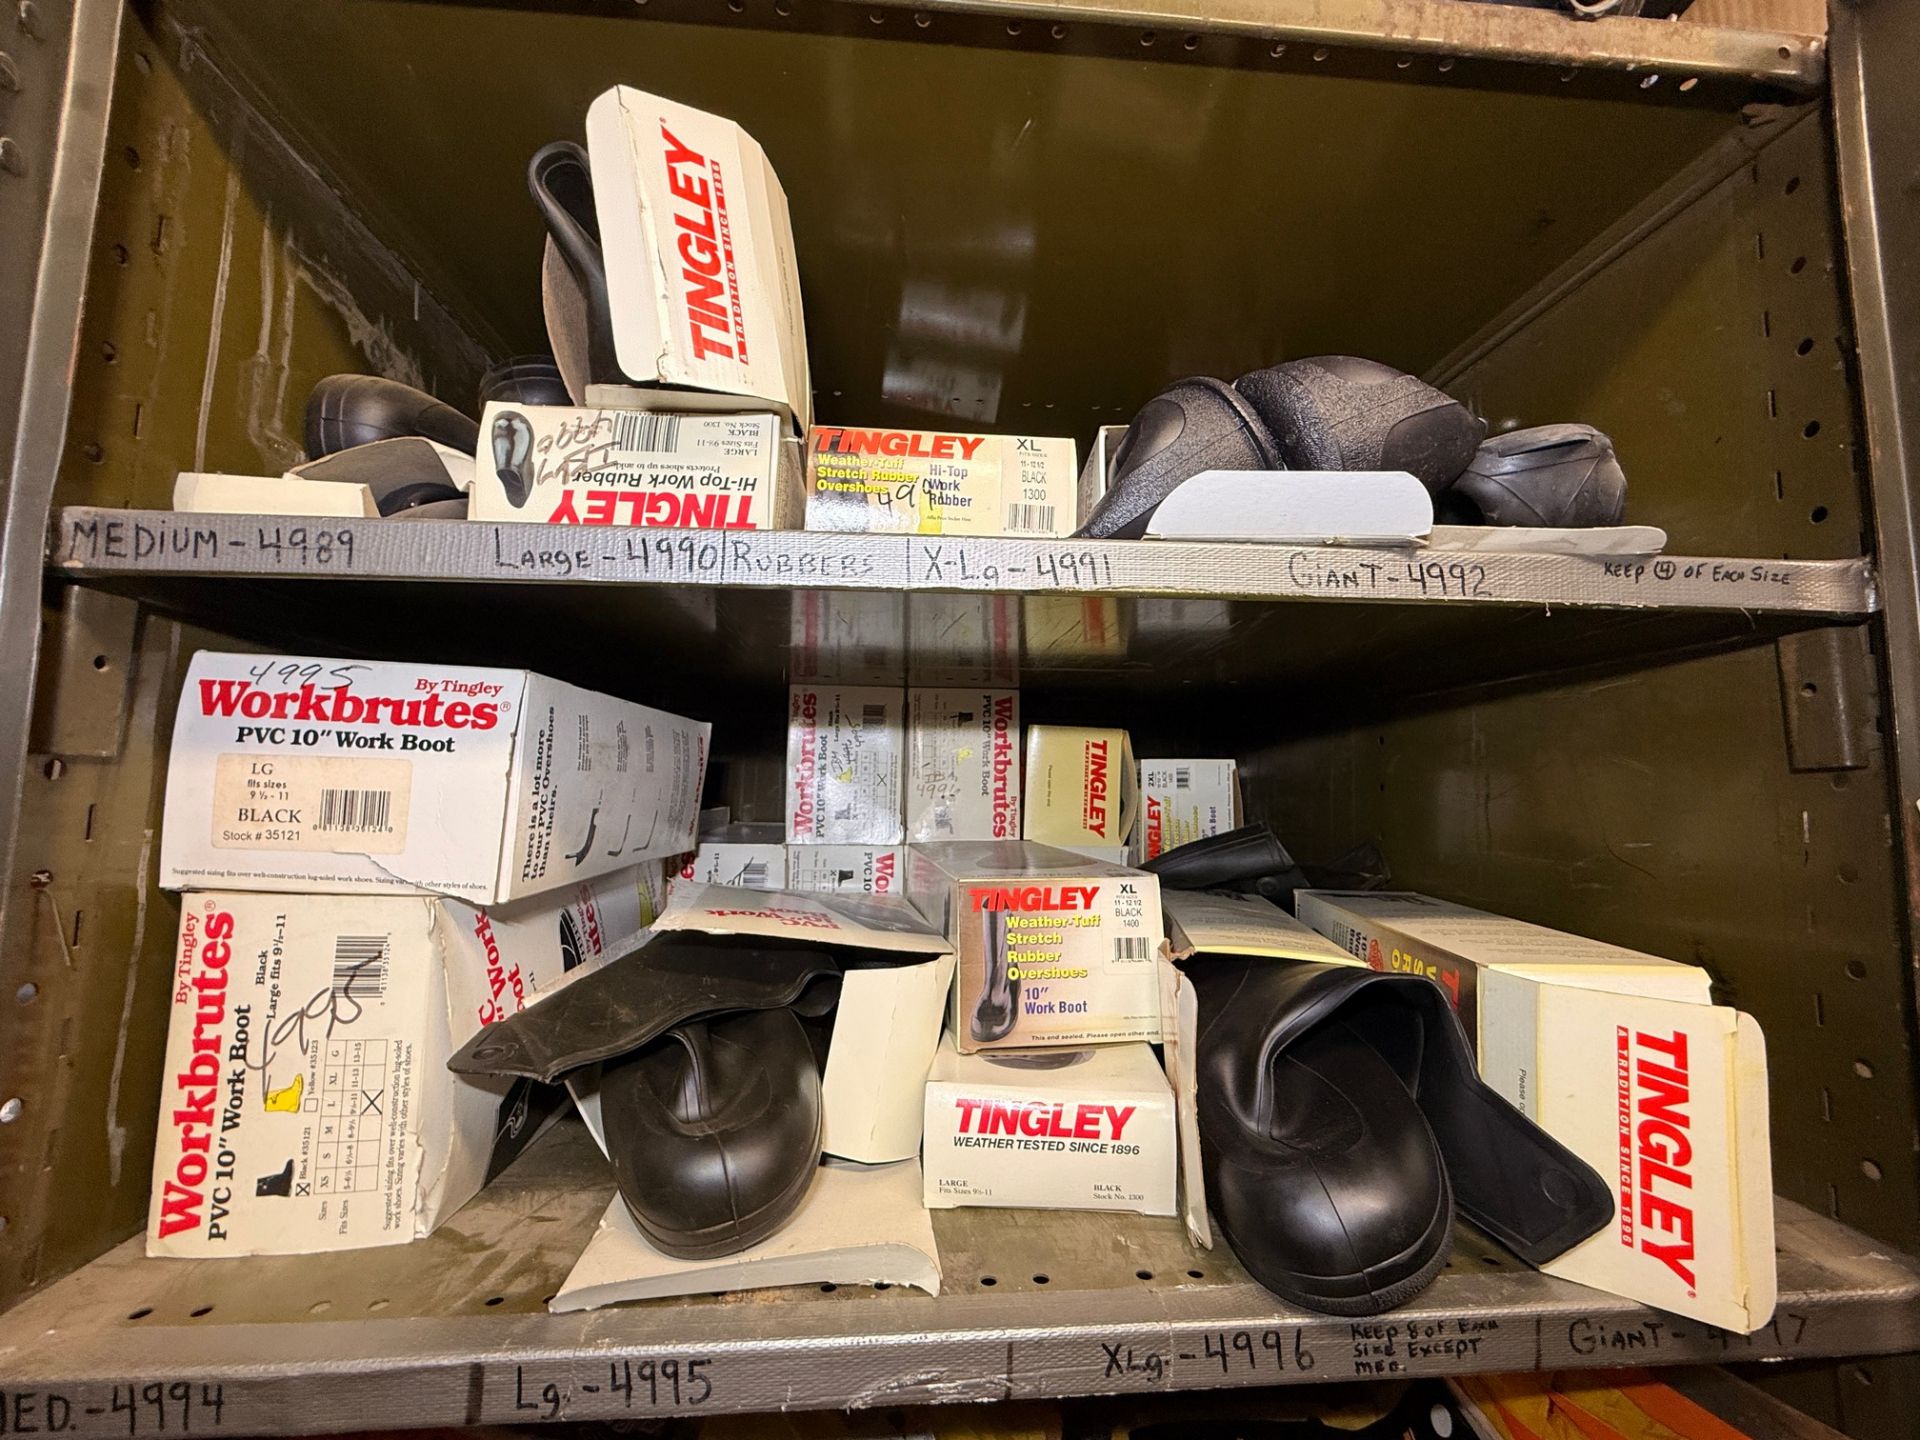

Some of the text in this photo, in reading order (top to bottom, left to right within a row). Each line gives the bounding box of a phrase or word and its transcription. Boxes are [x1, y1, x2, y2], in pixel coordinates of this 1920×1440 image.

[660, 125, 734, 360] TINGLEY
[711, 161, 745, 343] TRADITION SINCE 1896
[814, 428, 985, 460] TINGLEY
[1017, 439, 1042, 451] XL
[660, 464, 684, 472] shoes
[817, 466, 919, 483] Stretch Rubber
[930, 464, 968, 479] Hi-Top
[1022, 470, 1047, 484] BLACK
[572, 471, 757, 491] Hi-Top Work Rubber
[817, 480, 889, 494] Overshoes
[930, 479, 960, 491] Work
[1023, 489, 1046, 500] 1300
[548, 490, 757, 529] TINGLEY
[249, 661, 372, 691] 4995
[414, 677, 504, 698] By Tingley
[235, 727, 285, 745] PVC
[336, 731, 394, 750] Work
[400, 734, 456, 753] Boot
[818, 734, 828, 761] Boot
[981, 694, 991, 796] PVC Work Boot
[251, 762, 274, 776] LG
[993, 696, 1013, 838] Workbrutes
[247, 779, 287, 790] fits sizes
[530, 706, 555, 880] to our PVC Overshoes
[1088, 740, 1108, 839] TINGLEY
[237, 807, 302, 824] BLACK
[522, 729, 545, 882] There is lot more
[1008, 796, 1017, 838] By Tingley
[223, 830, 301, 841] Stock # 35121
[539, 784, 557, 878] than theirs.
[816, 814, 825, 838] PVC
[863, 852, 873, 876] PVC
[968, 886, 1100, 913] TINGLEY
[1119, 884, 1137, 894] XL
[1006, 915, 1101, 929] Weather-Tuff
[1115, 908, 1143, 917] BLACK
[1123, 919, 1139, 928] 1400
[1007, 932, 1063, 945] Stretch
[174, 911, 199, 1005] By Tingley
[474, 907, 506, 1002] Work
[1007, 950, 1062, 964] Rubber
[255, 950, 268, 985] Black
[1008, 967, 1088, 981] Overshoes
[266, 959, 282, 1019] Large fits
[1025, 1001, 1087, 1015] Work Boot
[228, 1004, 250, 1063] Boot
[307, 1072, 316, 1095] Yellow
[221, 1071, 246, 1132] Work
[955, 1098, 1136, 1140] TINGLEY
[299, 1127, 311, 1180] Black #35121
[319, 1072, 337, 1220] Sizes XS XL
[388, 1139, 396, 1155] over
[953, 1136, 1140, 1155] WEATHER TESTED SINCE 1896
[1618, 1049, 1633, 1242] TRADITION SINCE 1896
[1636, 1030, 1695, 1290] TINGLEY
[939, 1179, 968, 1187] LARGE
[953, 1187, 972, 1196] Sizes
[1094, 1184, 1122, 1192] BLACK
[207, 1187, 232, 1242] PVC
[340, 1200, 348, 1218] Sizes
[383, 1192, 394, 1230] Suggested
[393, 1211, 401, 1229] work
[339, 1220, 348, 1235] Fits
